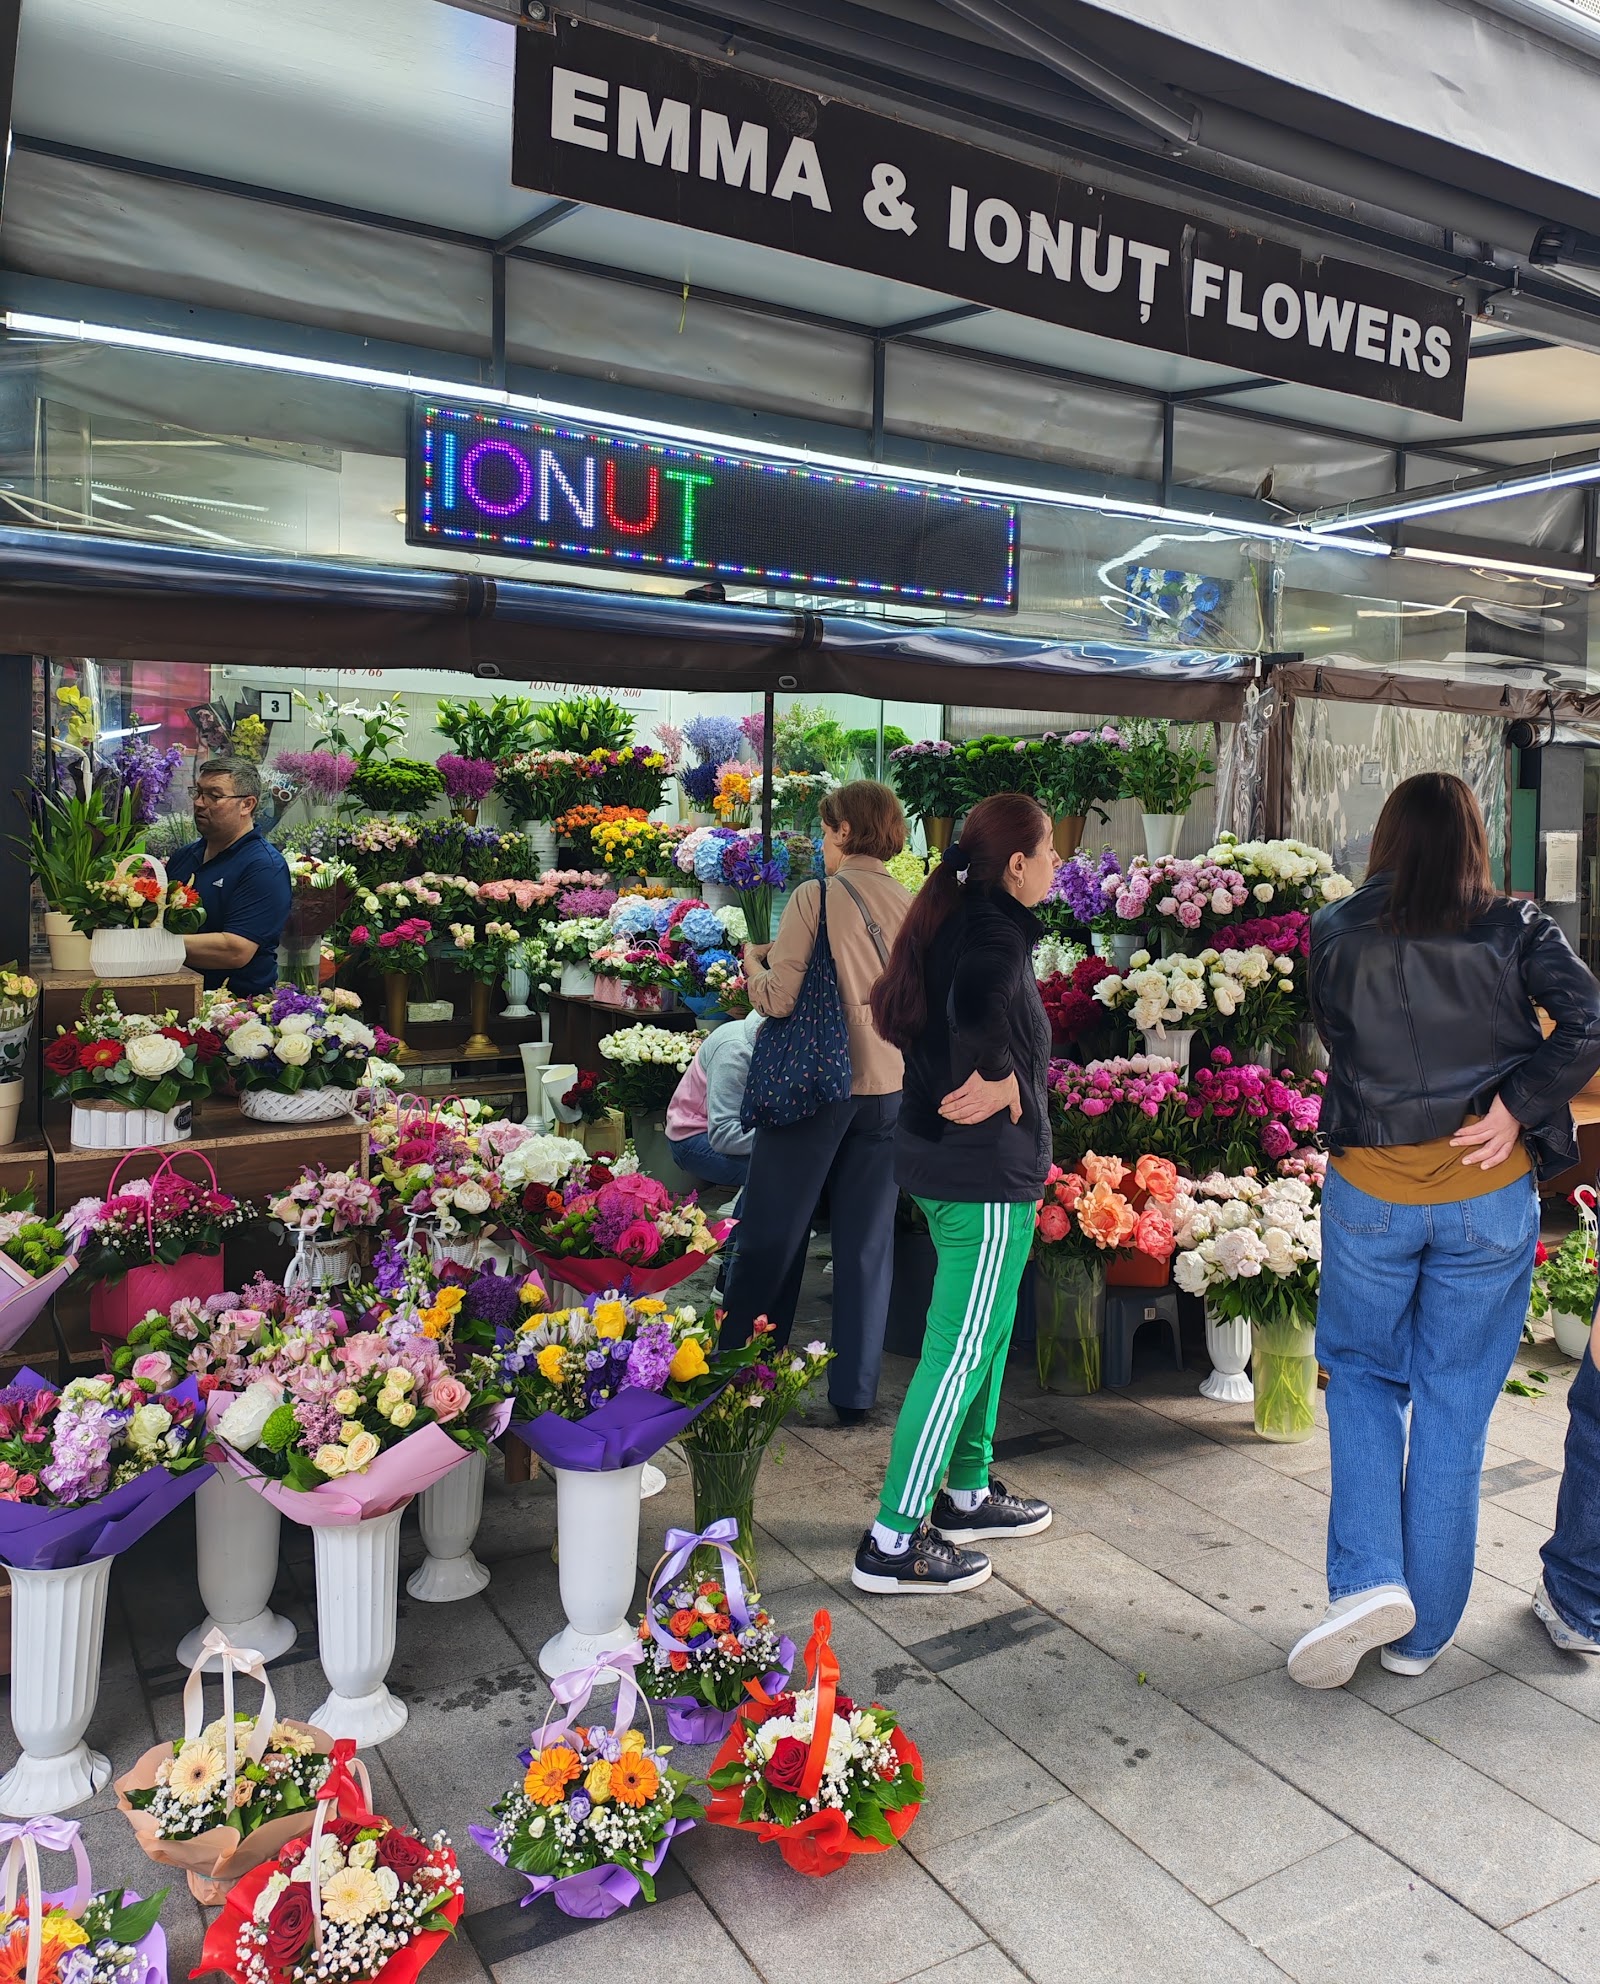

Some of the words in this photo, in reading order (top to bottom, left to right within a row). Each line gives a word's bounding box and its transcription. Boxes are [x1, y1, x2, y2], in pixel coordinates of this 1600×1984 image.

[551, 66, 832, 213] EMMA
[862, 162, 919, 237] &
[948, 185, 1170, 324] IONUȚ
[1190, 258, 1452, 379] FLOWERS
[271, 700, 280, 713] 3
